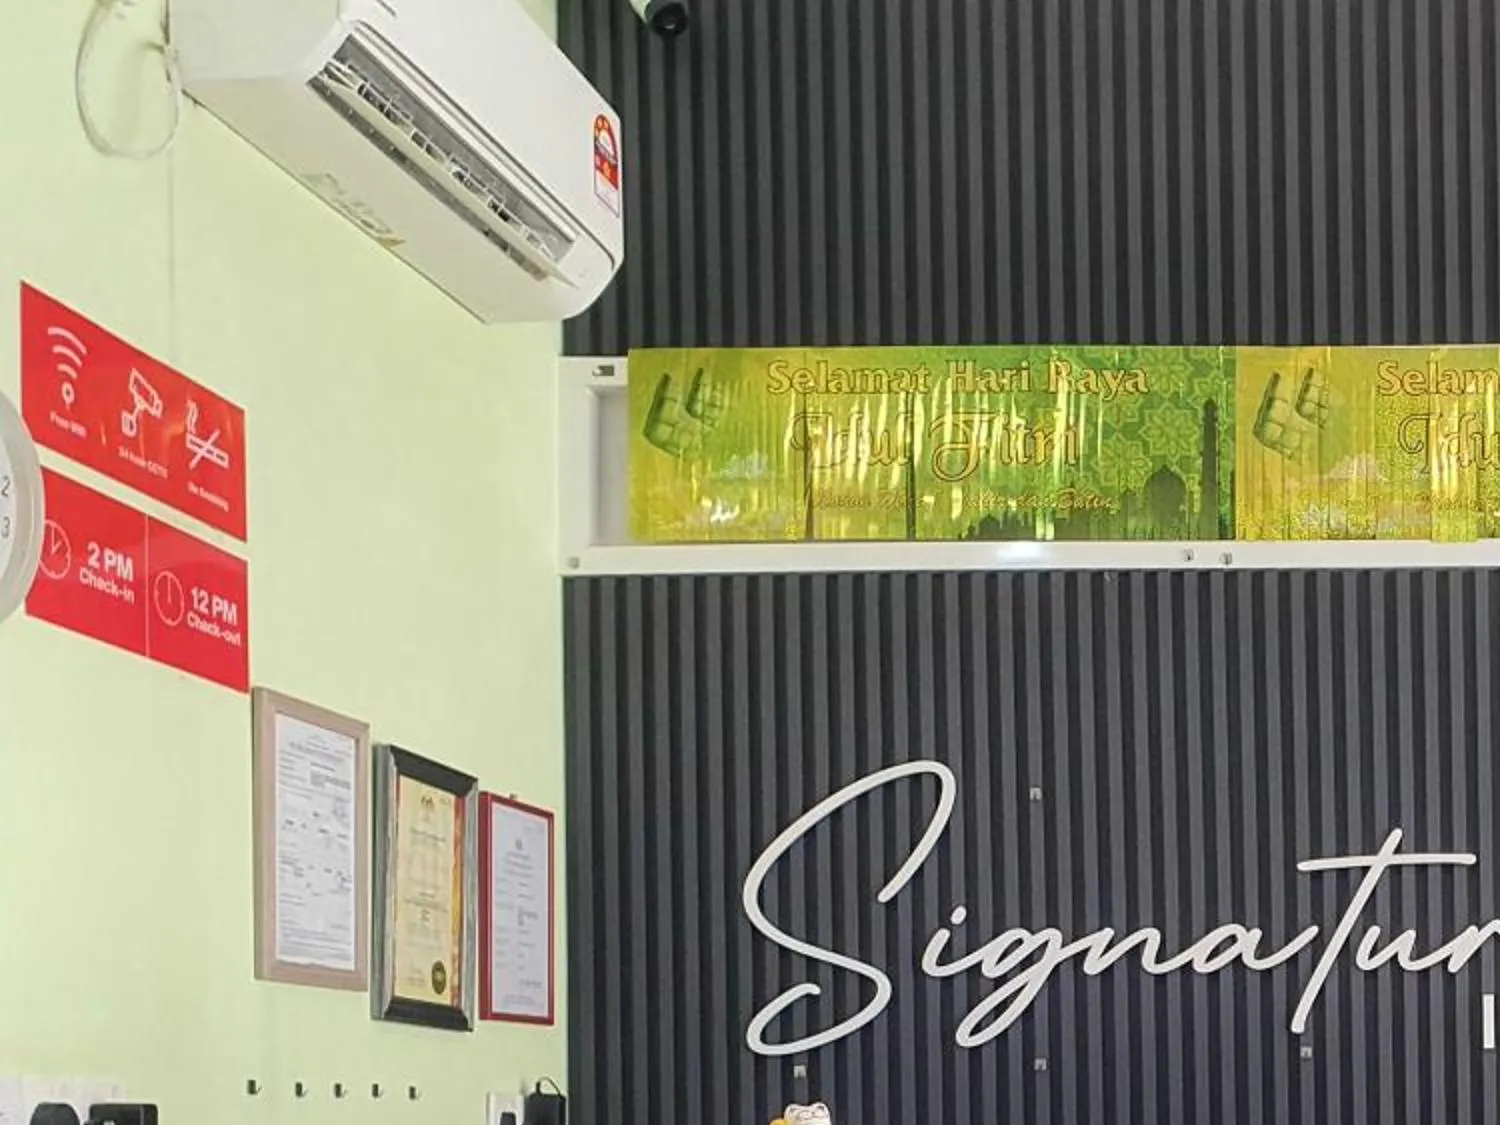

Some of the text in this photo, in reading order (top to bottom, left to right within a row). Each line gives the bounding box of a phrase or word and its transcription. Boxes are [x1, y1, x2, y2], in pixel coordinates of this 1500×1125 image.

[767, 357, 1149, 400] Selamat Hari Raya
[87, 541, 134, 582] 2 PM
[79, 567, 135, 604] Check-in
[191, 586, 238, 626] 12 PM
[186, 611, 242, 646] Check-out
